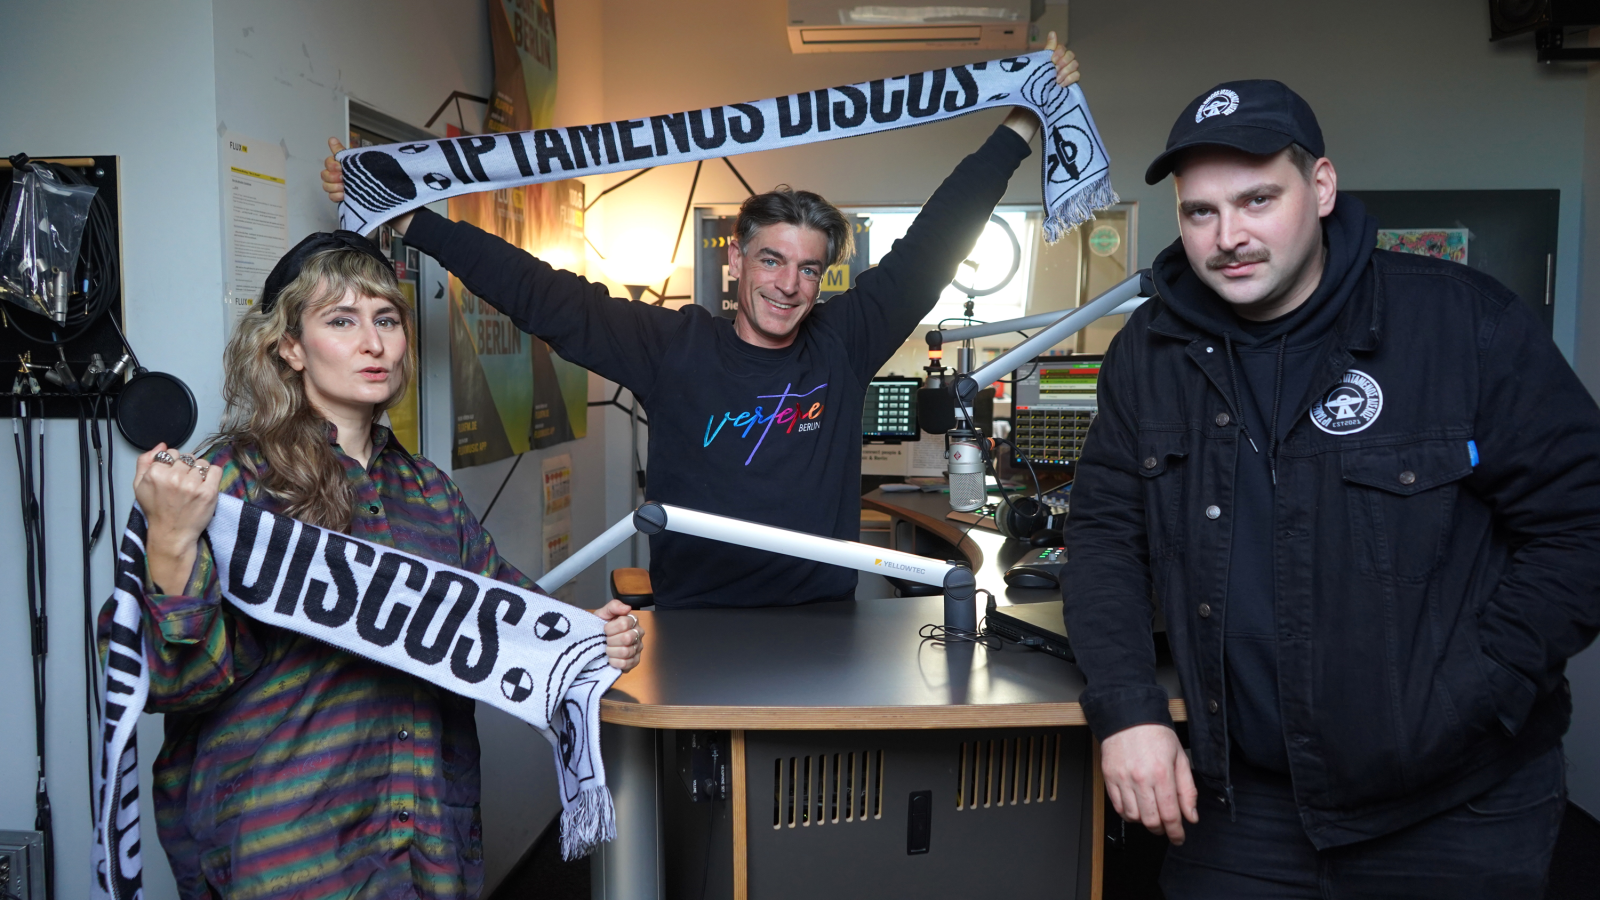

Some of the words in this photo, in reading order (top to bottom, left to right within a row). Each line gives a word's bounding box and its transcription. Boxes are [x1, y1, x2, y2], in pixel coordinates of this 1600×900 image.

[437, 101, 765, 185] IPTAMENOS
[776, 61, 988, 139] DISCOS
[478, 319, 521, 355] BERLIN
[798, 421, 821, 433] BERLIN
[883, 560, 926, 575] YELLOWTEC
[228, 502, 527, 684] DISCOS
